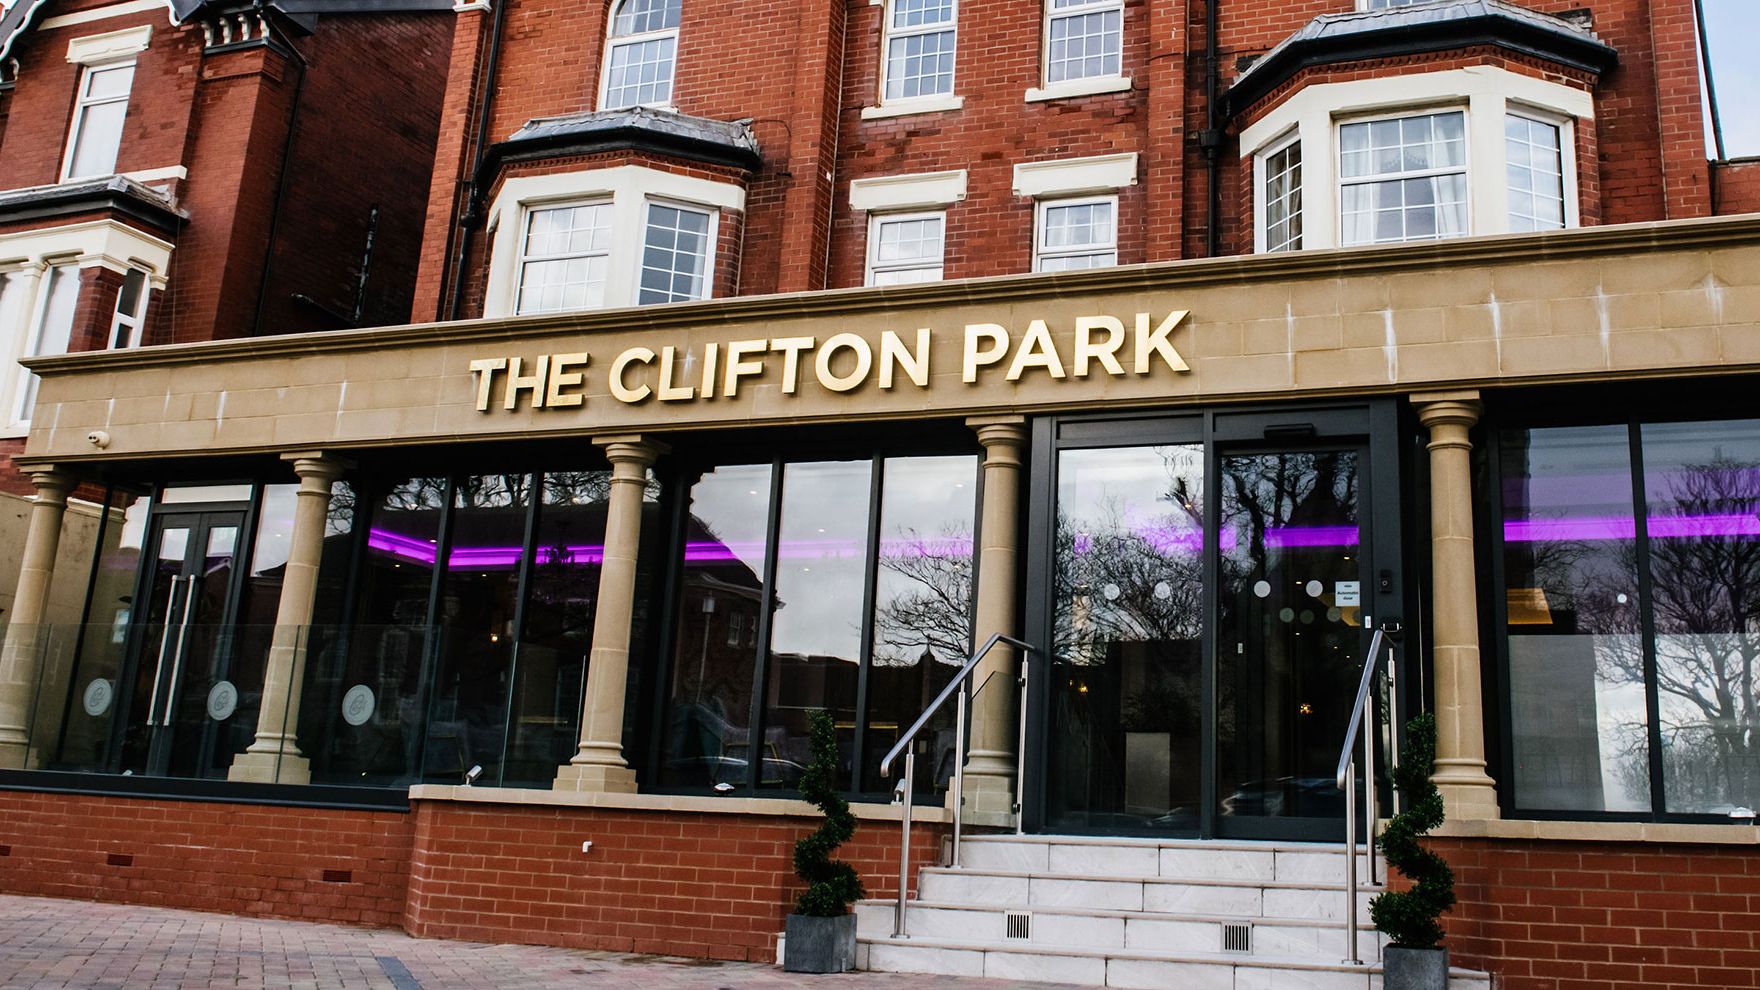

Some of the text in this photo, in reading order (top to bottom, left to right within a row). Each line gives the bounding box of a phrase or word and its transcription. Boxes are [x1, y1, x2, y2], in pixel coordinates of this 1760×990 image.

[469, 310, 1191, 411] THE CLIFTON PARK
